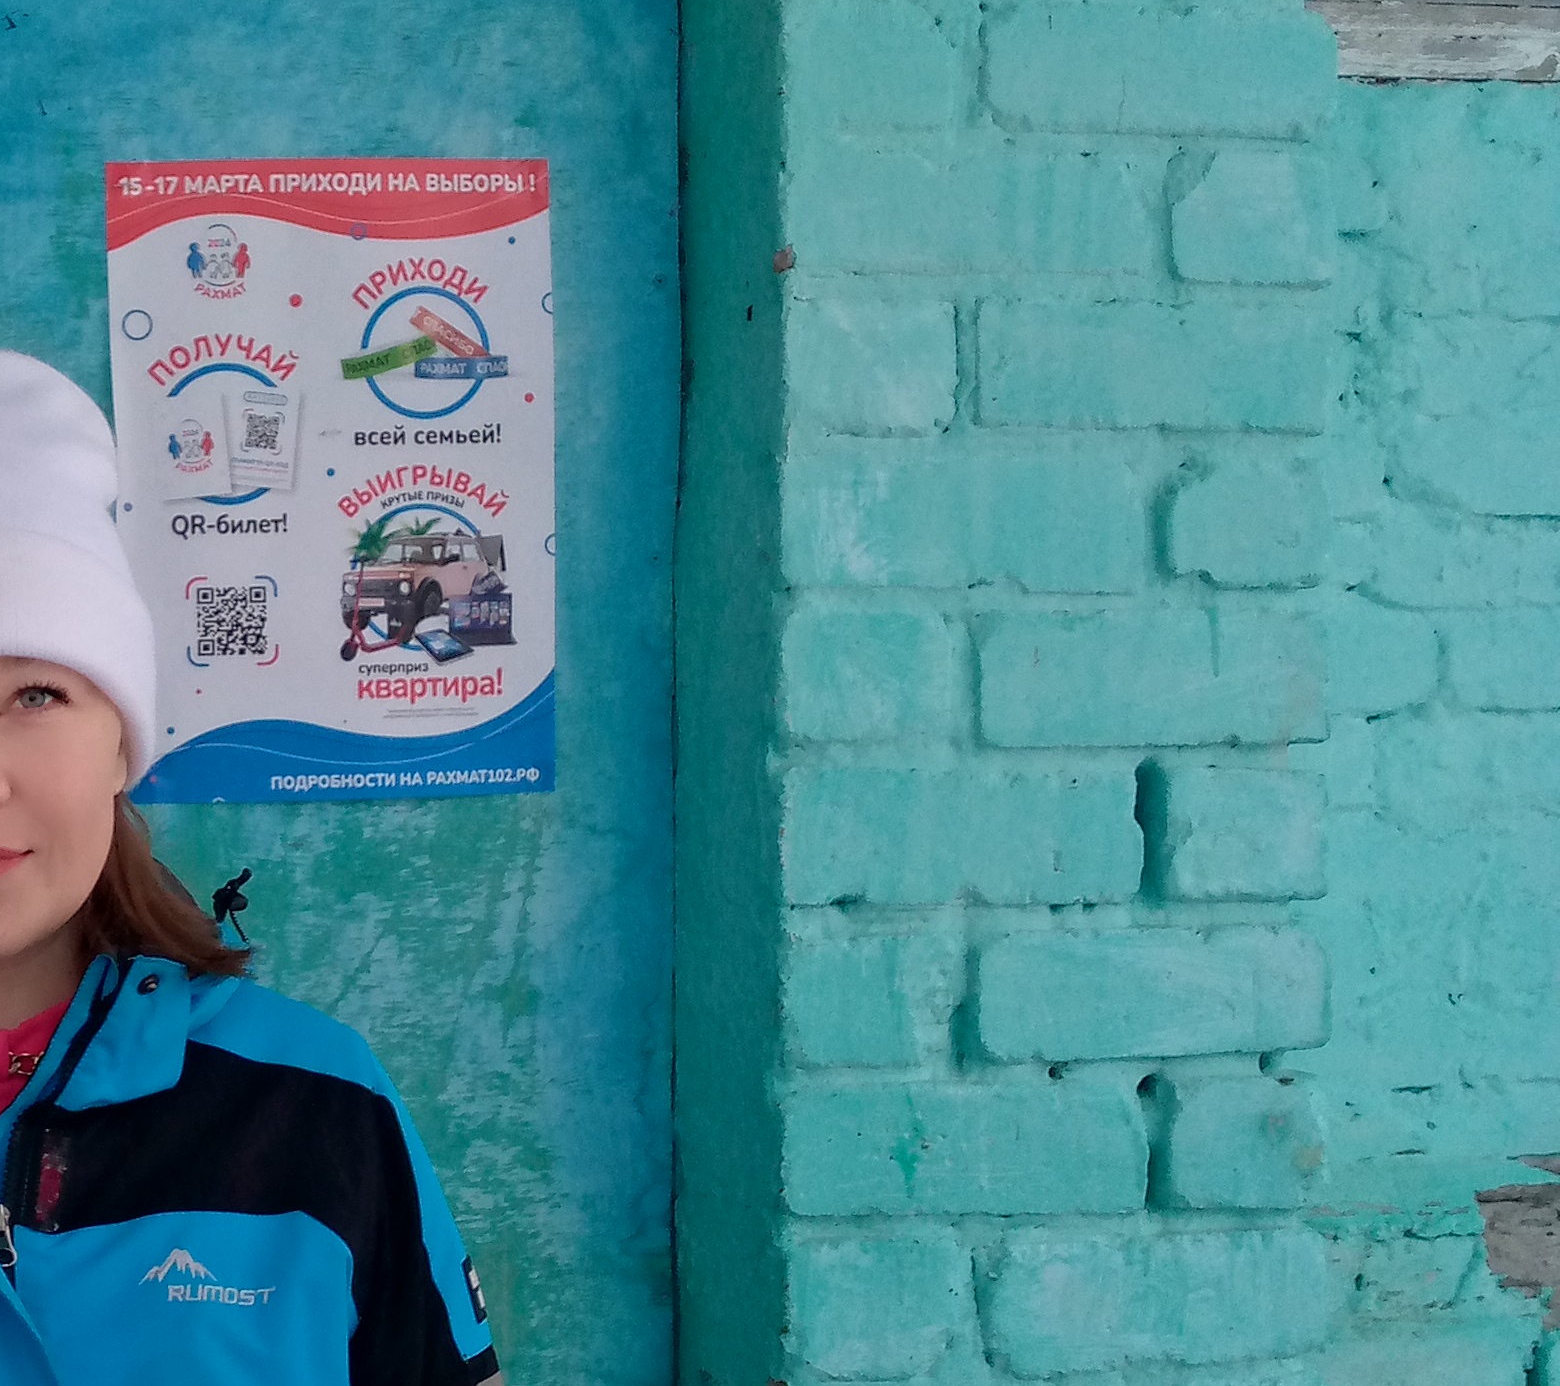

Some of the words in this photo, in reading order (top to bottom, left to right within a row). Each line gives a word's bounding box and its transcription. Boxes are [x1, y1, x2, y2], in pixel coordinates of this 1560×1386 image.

[118, 176, 178, 195] 15-17
[185, 174, 263, 193] МАРТА
[269, 172, 382, 195] ПРИХОДИ
[388, 173, 420, 192] НА
[193, 282, 247, 300] РАХМАТ
[351, 257, 489, 311] ПРИХОДИ
[147, 333, 299, 386] ПОЛУЧАЙ
[353, 425, 406, 445] всей
[414, 423, 502, 445] семьей!
[338, 465, 509, 518] ВЫИГРЫВАЙ
[380, 490, 425, 509] КРУТЫЕ
[426, 490, 466, 509] ПРИЗЫ
[171, 513, 288, 540] QR-билет!
[358, 662, 429, 675] суперприз
[357, 667, 504, 704] квартира!
[271, 773, 396, 792] ПОДРОБНОСТИ
[400, 772, 423, 787] НА
[426, 766, 541, 786] РАХМАТ102.РФ
